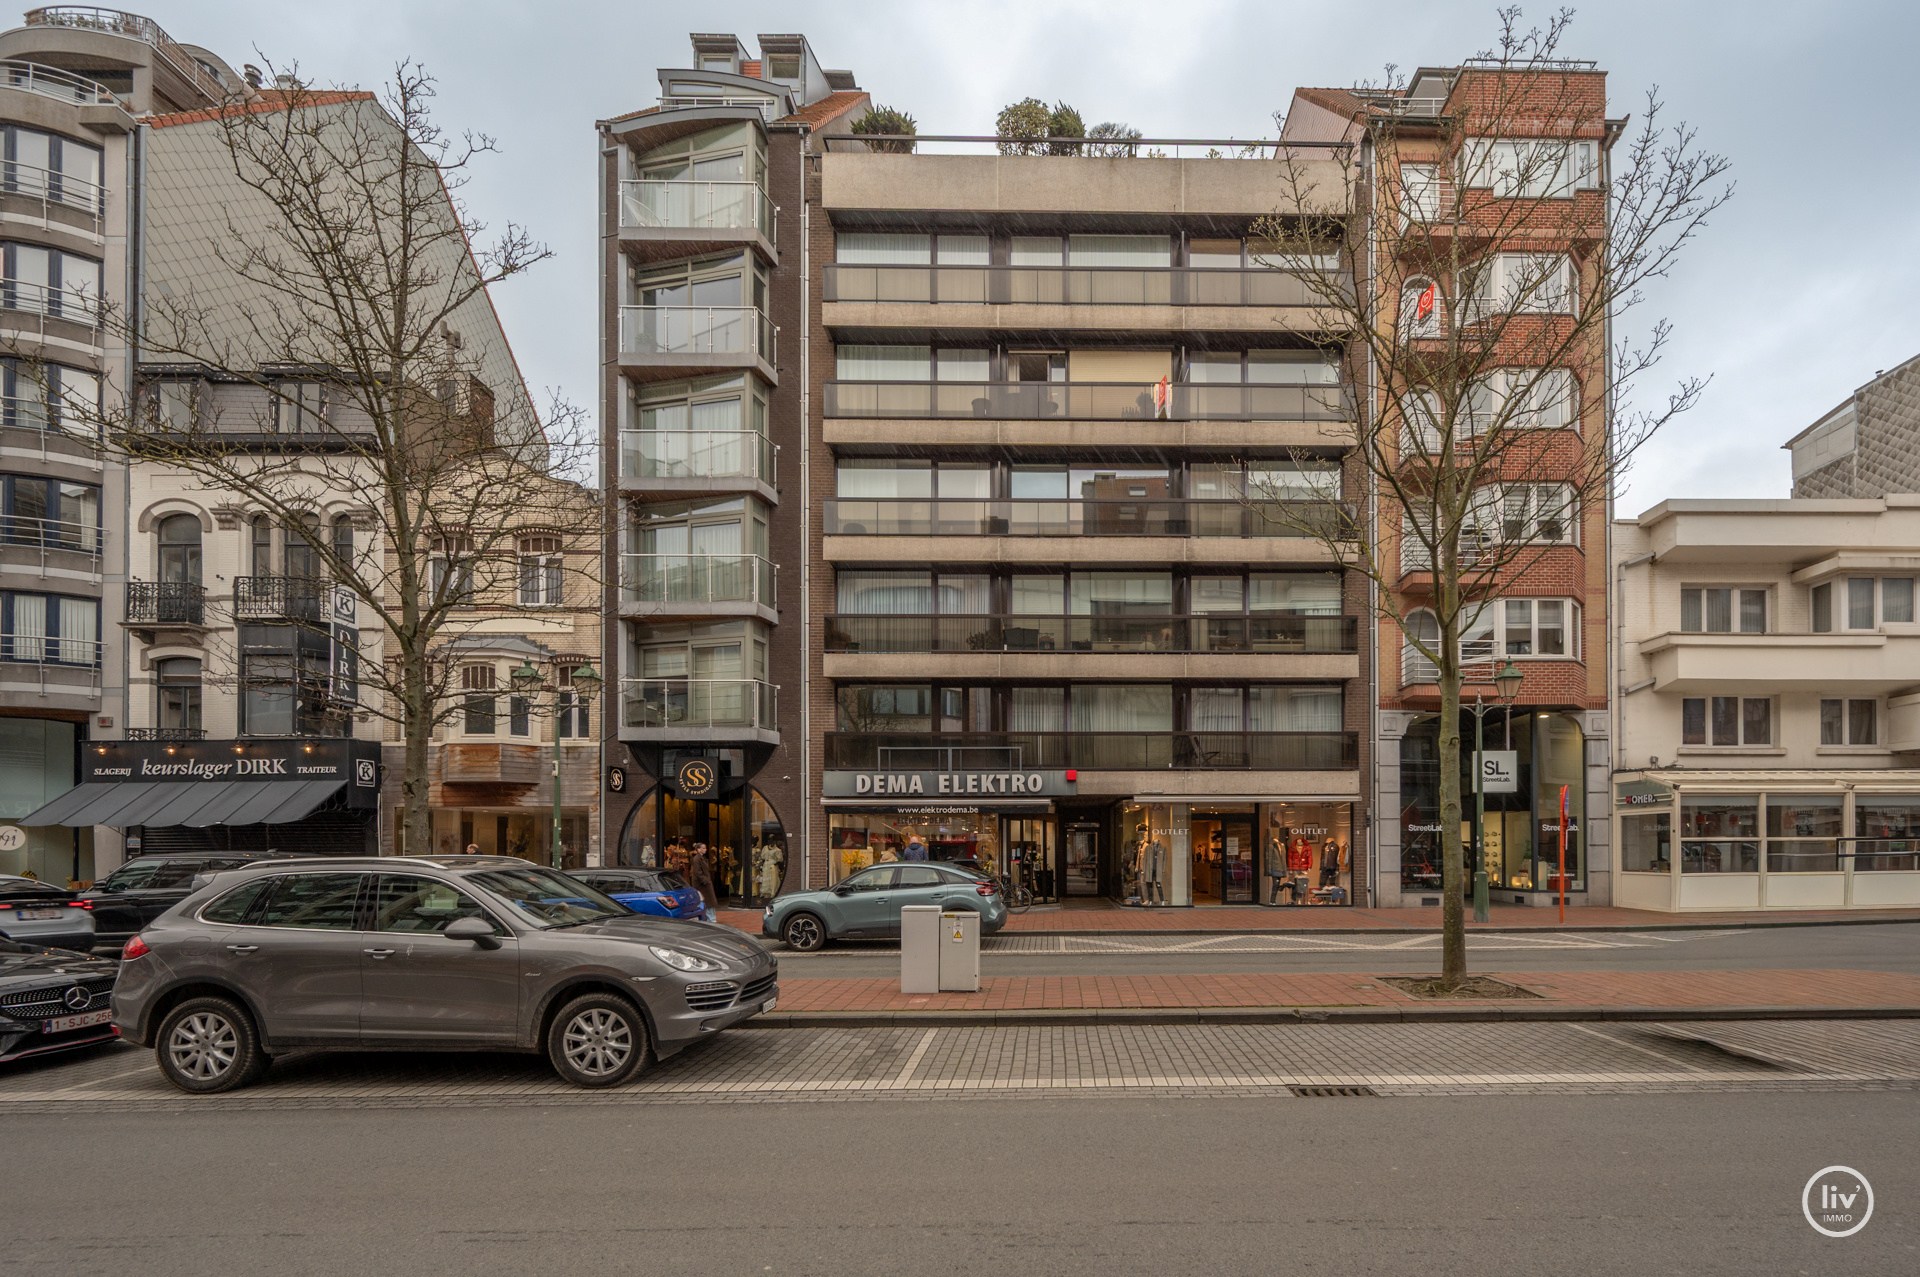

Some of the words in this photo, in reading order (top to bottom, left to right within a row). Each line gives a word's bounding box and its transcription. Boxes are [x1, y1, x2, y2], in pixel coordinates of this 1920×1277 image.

[94, 767, 132, 777] SLAGERIJ
[141, 759, 232, 779] keurslager
[236, 758, 287, 775] DIRK
[297, 766, 337, 774] TRAITEUR
[856, 774, 924, 793] DEMA
[938, 774, 1043, 793] ELEKTRO
[897, 806, 979, 814] www.elektrodema.be
[1151, 828, 1190, 836] OUTLET
